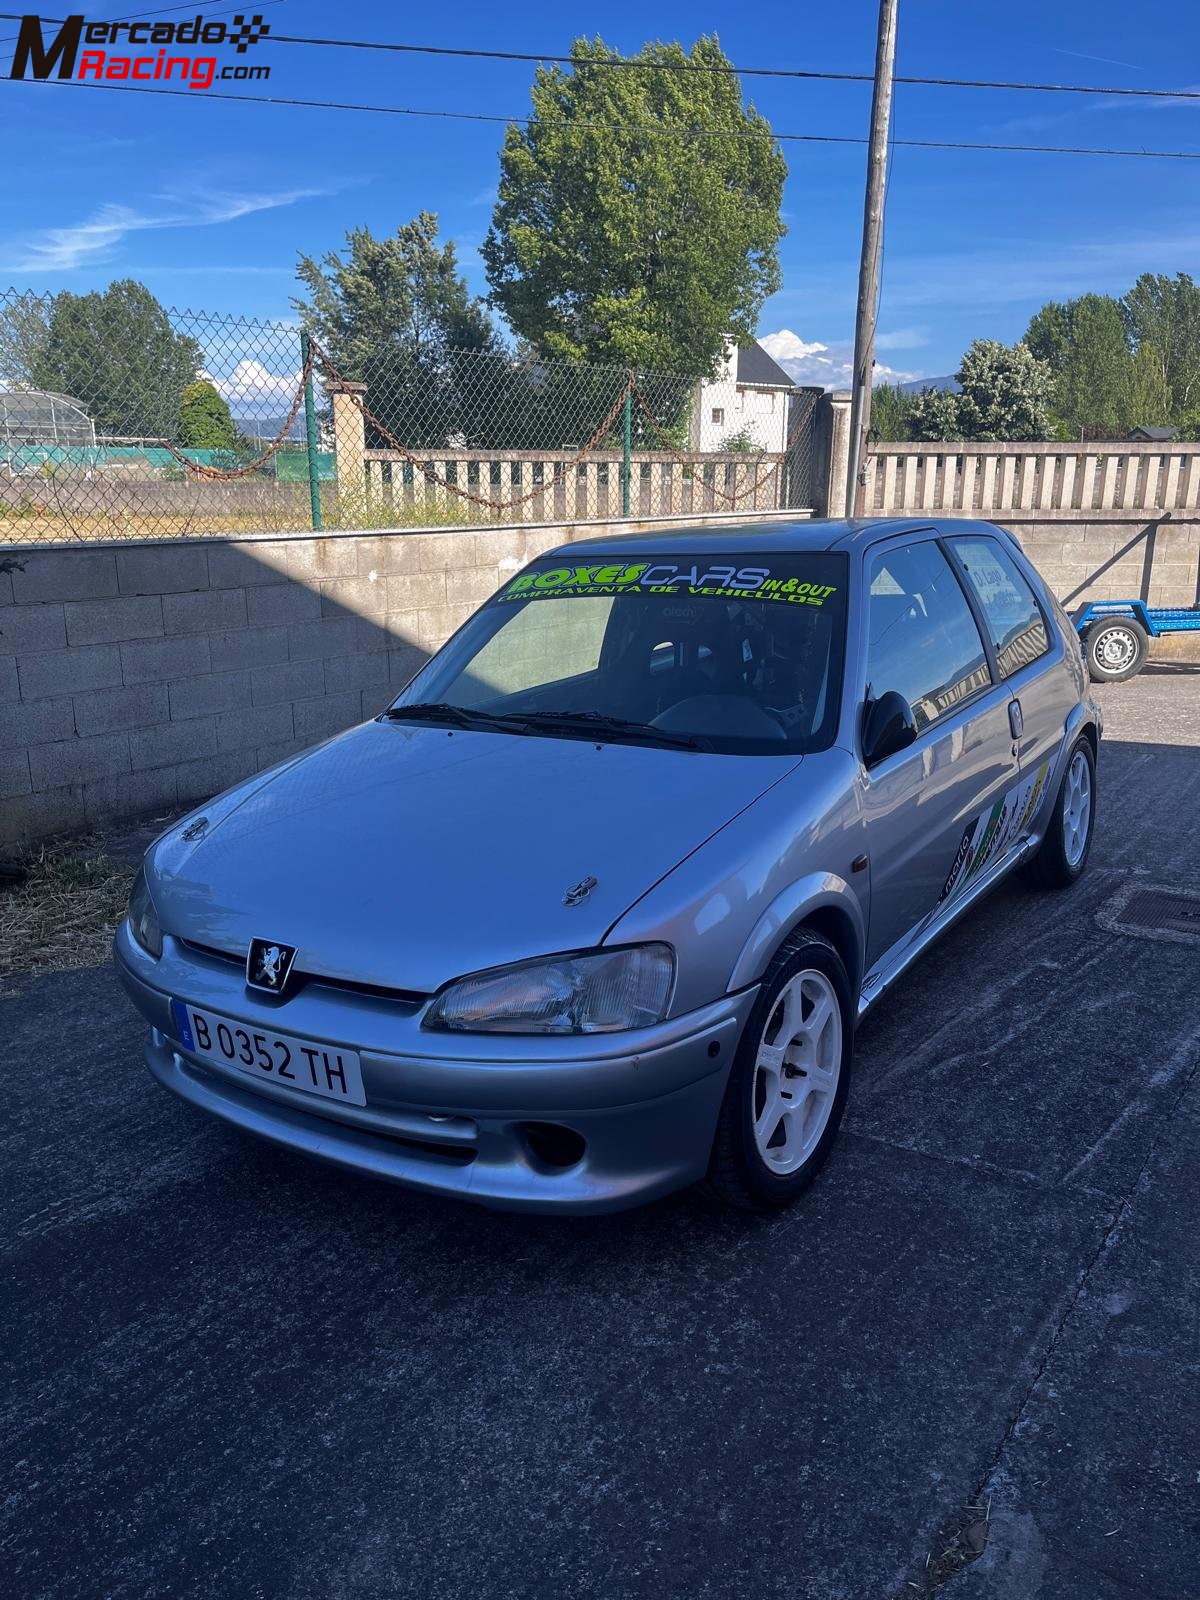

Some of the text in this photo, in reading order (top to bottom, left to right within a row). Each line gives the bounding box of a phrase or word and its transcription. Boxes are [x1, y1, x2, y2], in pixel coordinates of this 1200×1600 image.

[506, 563, 651, 594] BOXES
[498, 585, 824, 606] COMPRAVENTA DE VEHICULOS
[193, 1013, 348, 1094] B 0352 TH
